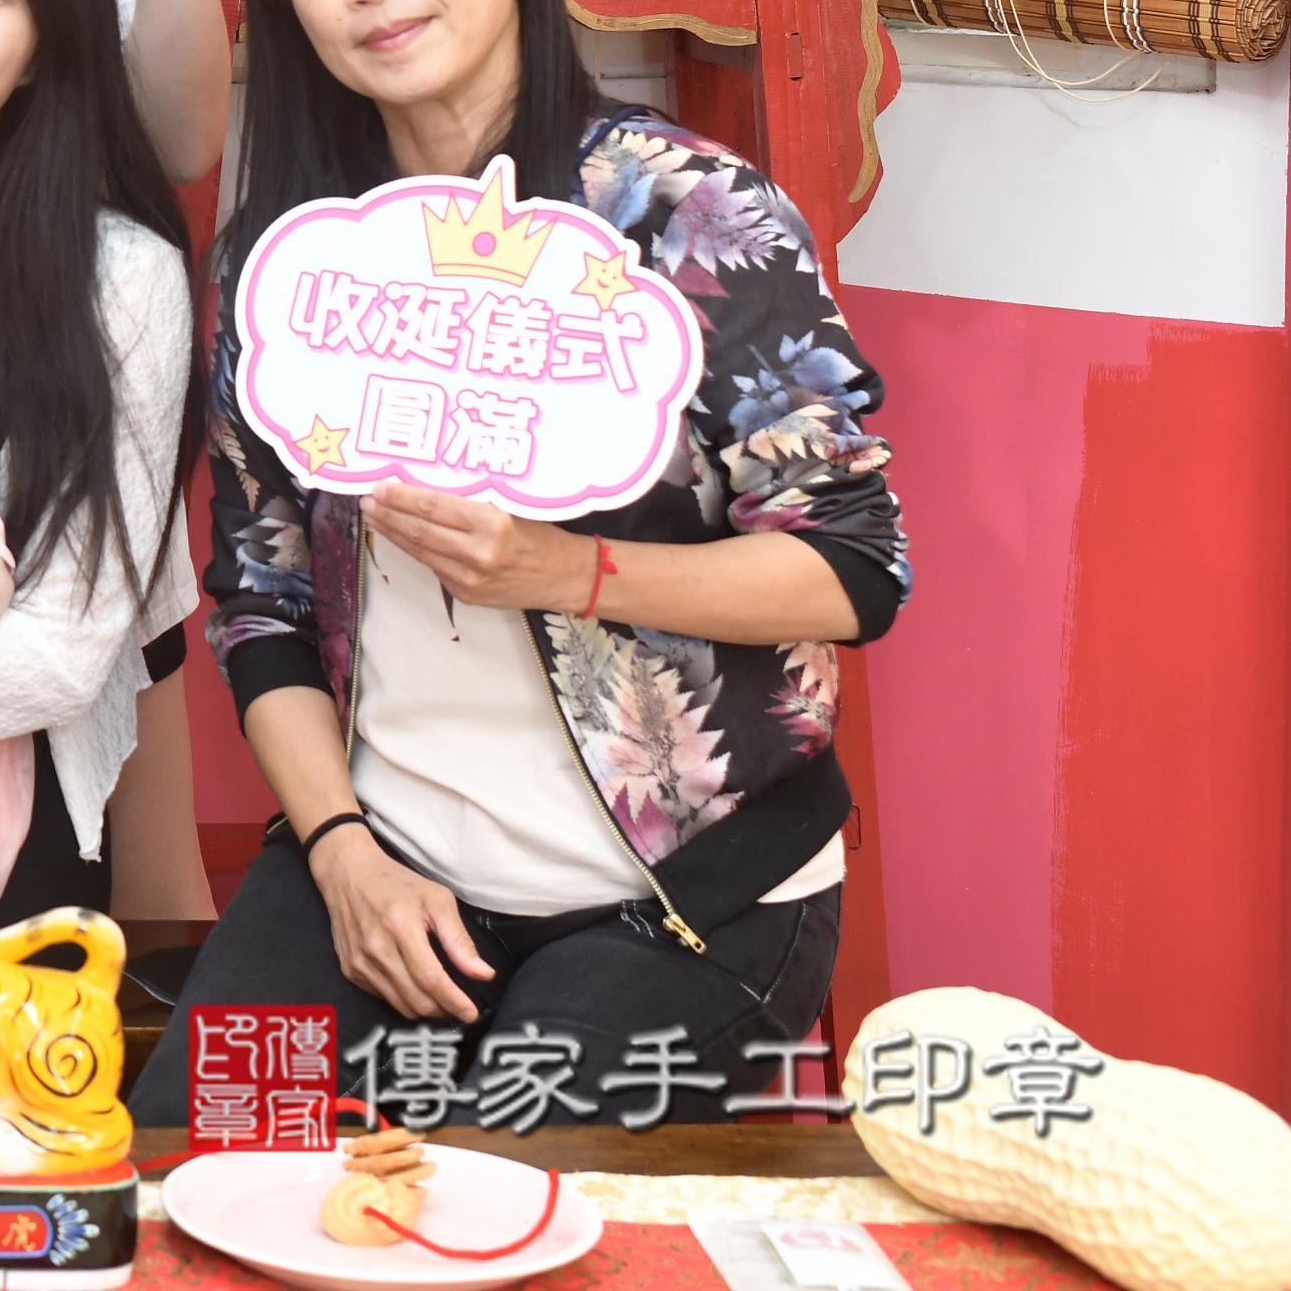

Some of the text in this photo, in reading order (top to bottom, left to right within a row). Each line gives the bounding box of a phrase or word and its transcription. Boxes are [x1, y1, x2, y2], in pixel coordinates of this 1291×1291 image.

[289, 271, 645, 394] 收涎儀式
[356, 375, 539, 478] 圓滿
